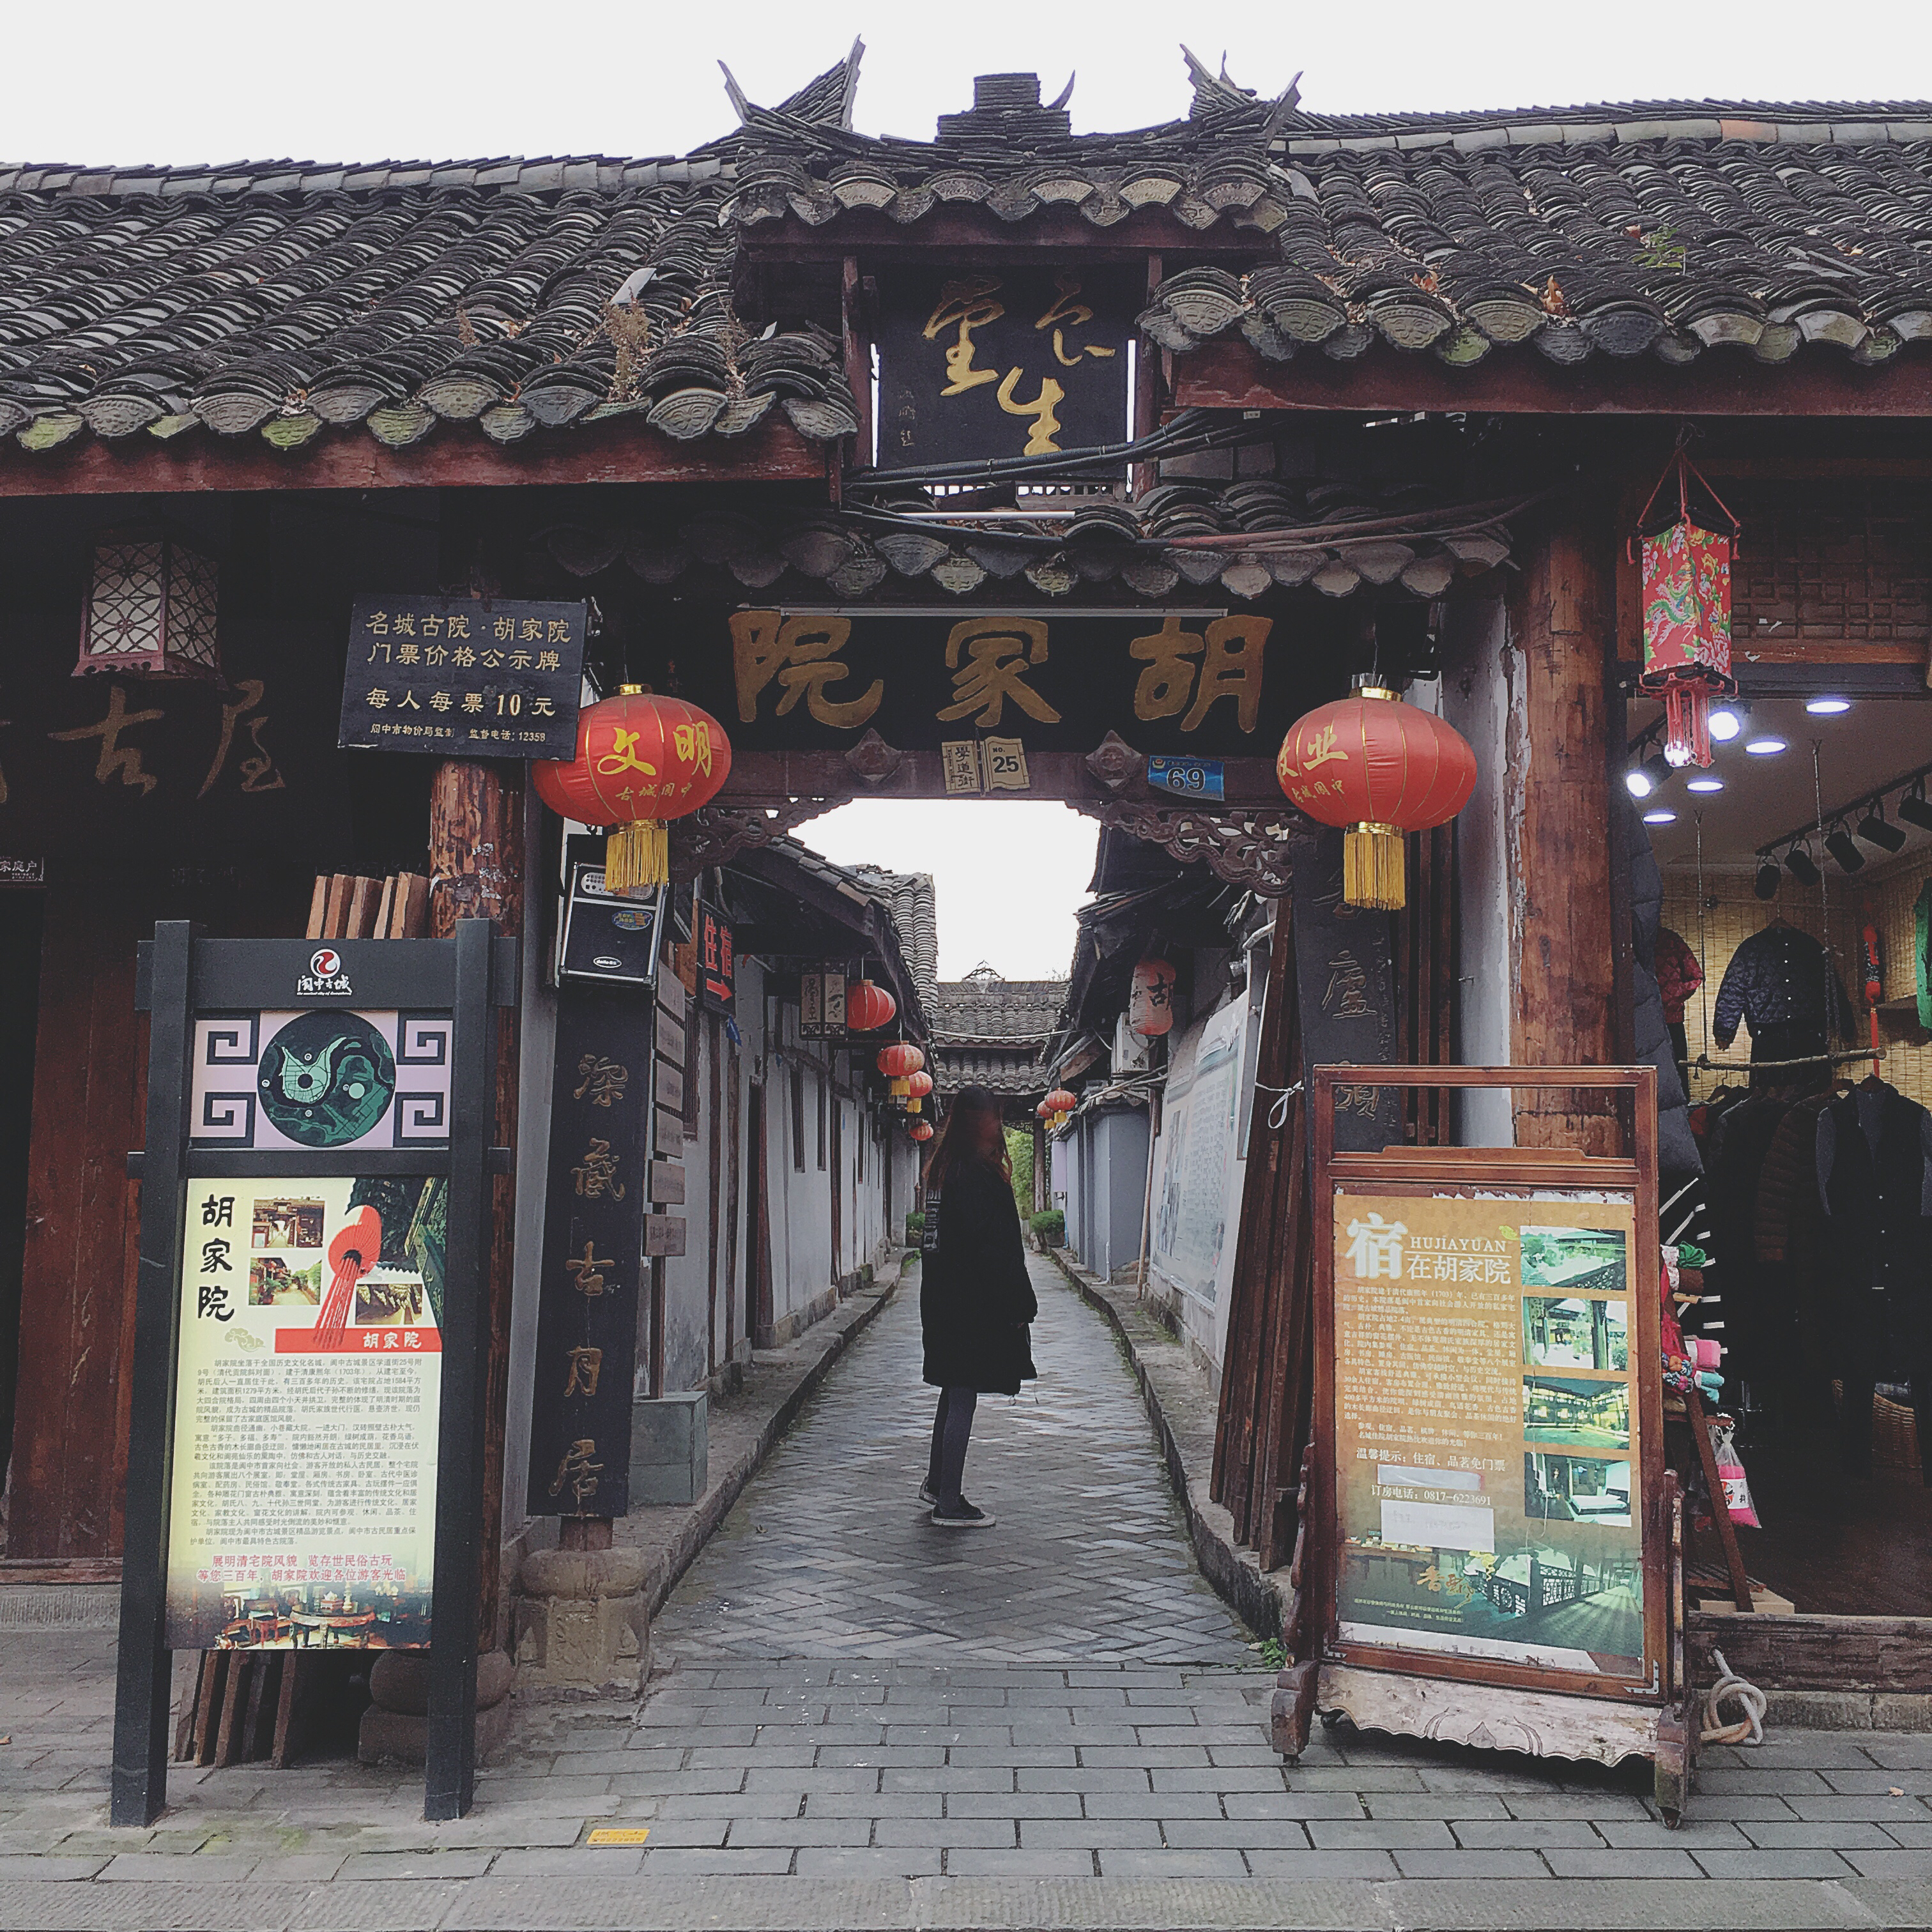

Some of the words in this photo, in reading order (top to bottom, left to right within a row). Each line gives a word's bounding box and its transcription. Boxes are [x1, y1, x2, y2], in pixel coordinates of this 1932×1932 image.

[367, 643, 561, 672] 门票价格公示牌
[730, 613, 1273, 733] 胡家院
[597, 721, 712, 778] 文明
[992, 755, 1019, 773] 25
[1166, 767, 1206, 792] 69
[704, 913, 732, 979] 住宿
[197, 1193, 236, 1322] 胡家院
[1346, 1212, 1409, 1278] 宿
[1410, 1236, 1506, 1252] HUJIAYUAN
[1406, 1255, 1511, 1285] 在胡家院
[362, 1331, 422, 1350] 胡家院
[211, 1554, 298, 1568] 展明清宅院风貌
[308, 1553, 393, 1567] 览存世民俗古玩
